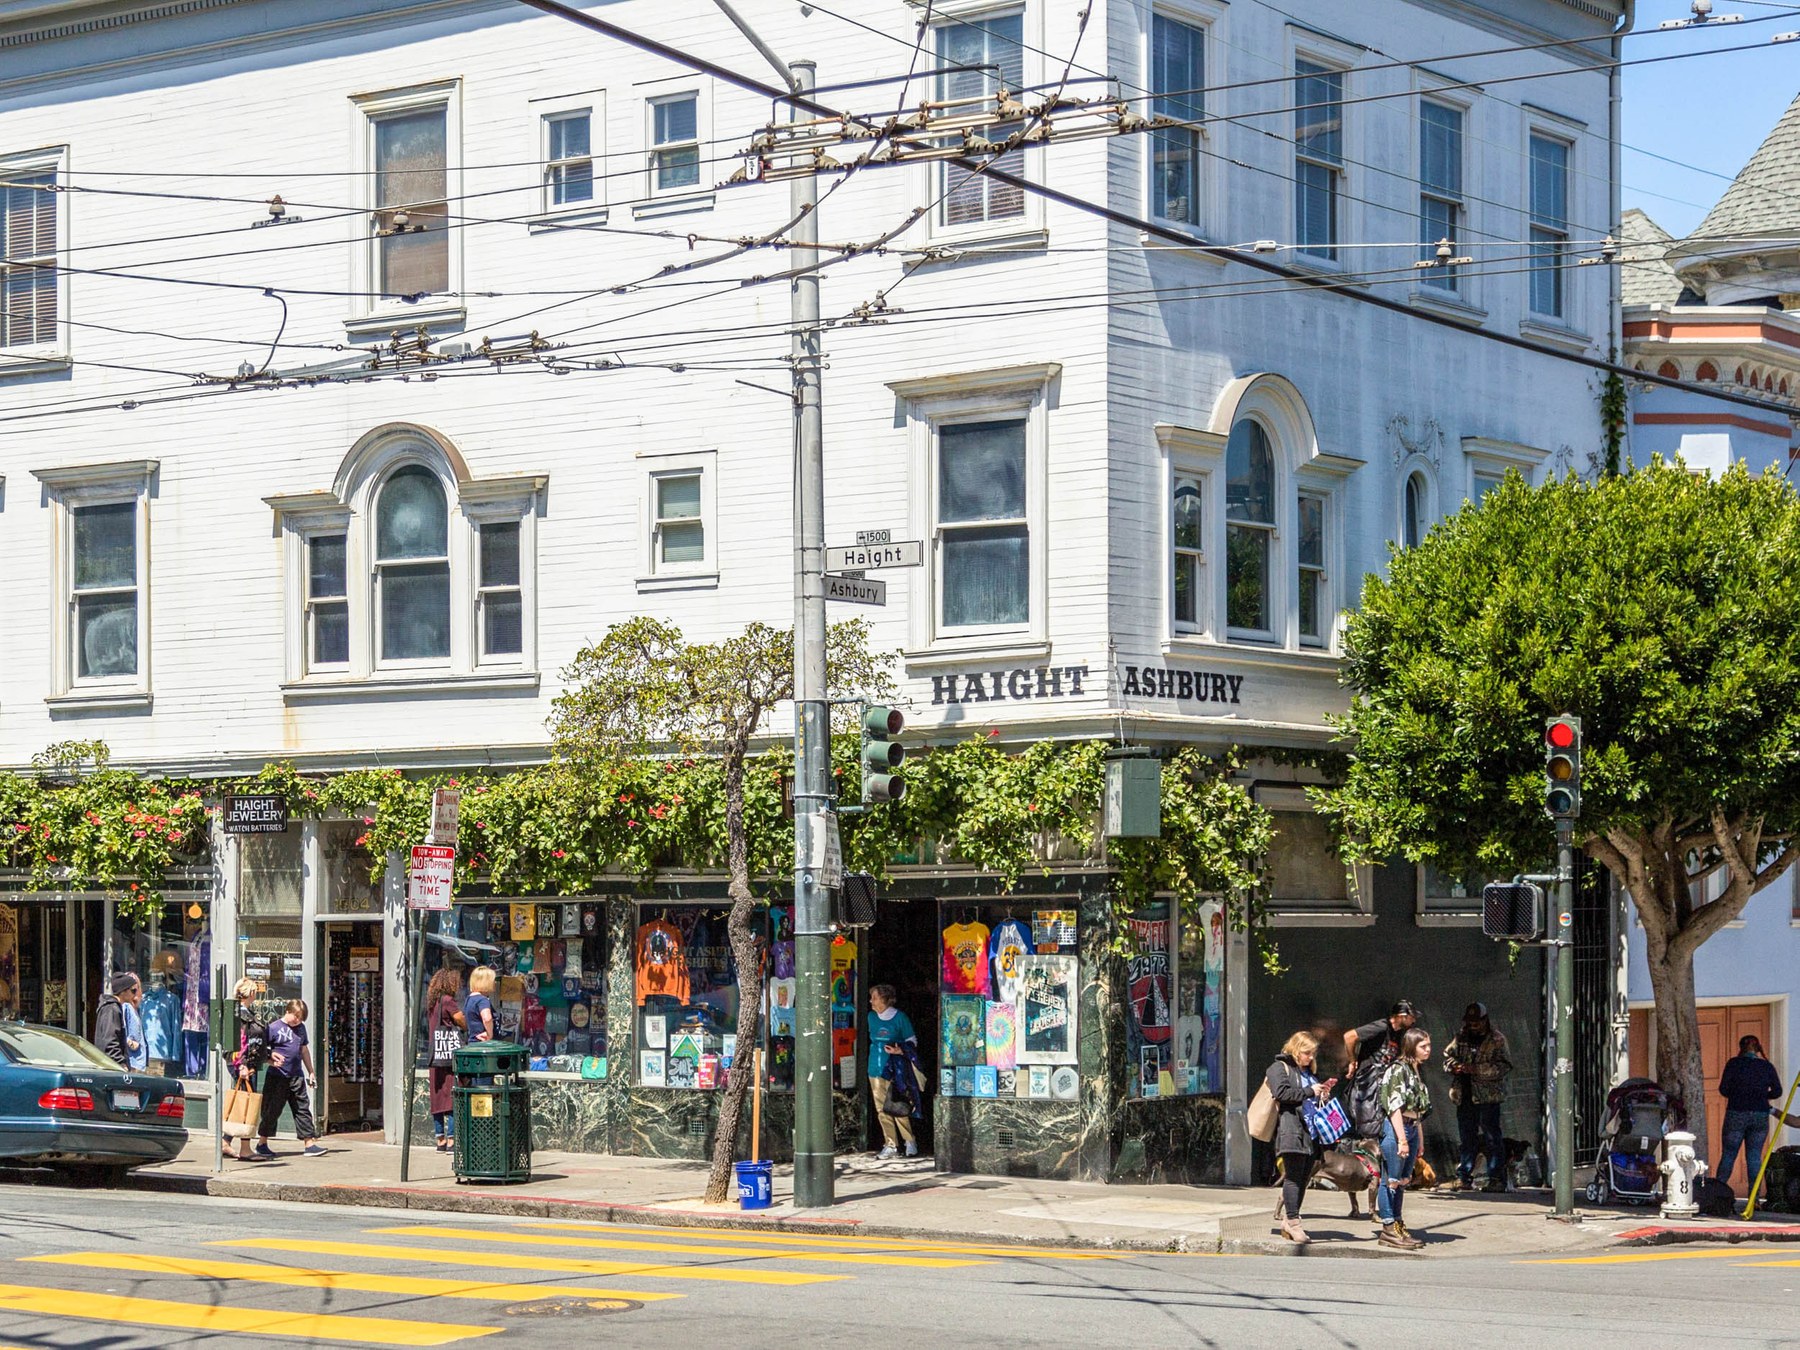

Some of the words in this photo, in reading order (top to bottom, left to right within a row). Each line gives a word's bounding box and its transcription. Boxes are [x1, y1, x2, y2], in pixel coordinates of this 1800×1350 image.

[866, 531, 887, 542] 1500
[844, 547, 902, 567] Haight
[830, 581, 879, 603] Ashbury
[931, 665, 1089, 706] HAIGHT
[1122, 666, 1244, 704] ASHBURY
[234, 799, 275, 811] HAIGHT
[226, 810, 284, 822] JEWELERY
[228, 824, 250, 832] WATCH
[251, 823, 283, 832] BATTERIES
[418, 848, 448, 858] TOW-AWAY
[412, 857, 424, 869] NO
[424, 860, 452, 870] STOPPING
[421, 875, 440, 884] ANY
[419, 885, 440, 896] TIME
[434, 1030, 459, 1040] BLACK
[434, 1040, 461, 1051] LIVES
[434, 1051, 453, 1060] MATT
[1680, 1180, 1689, 1194] 8
